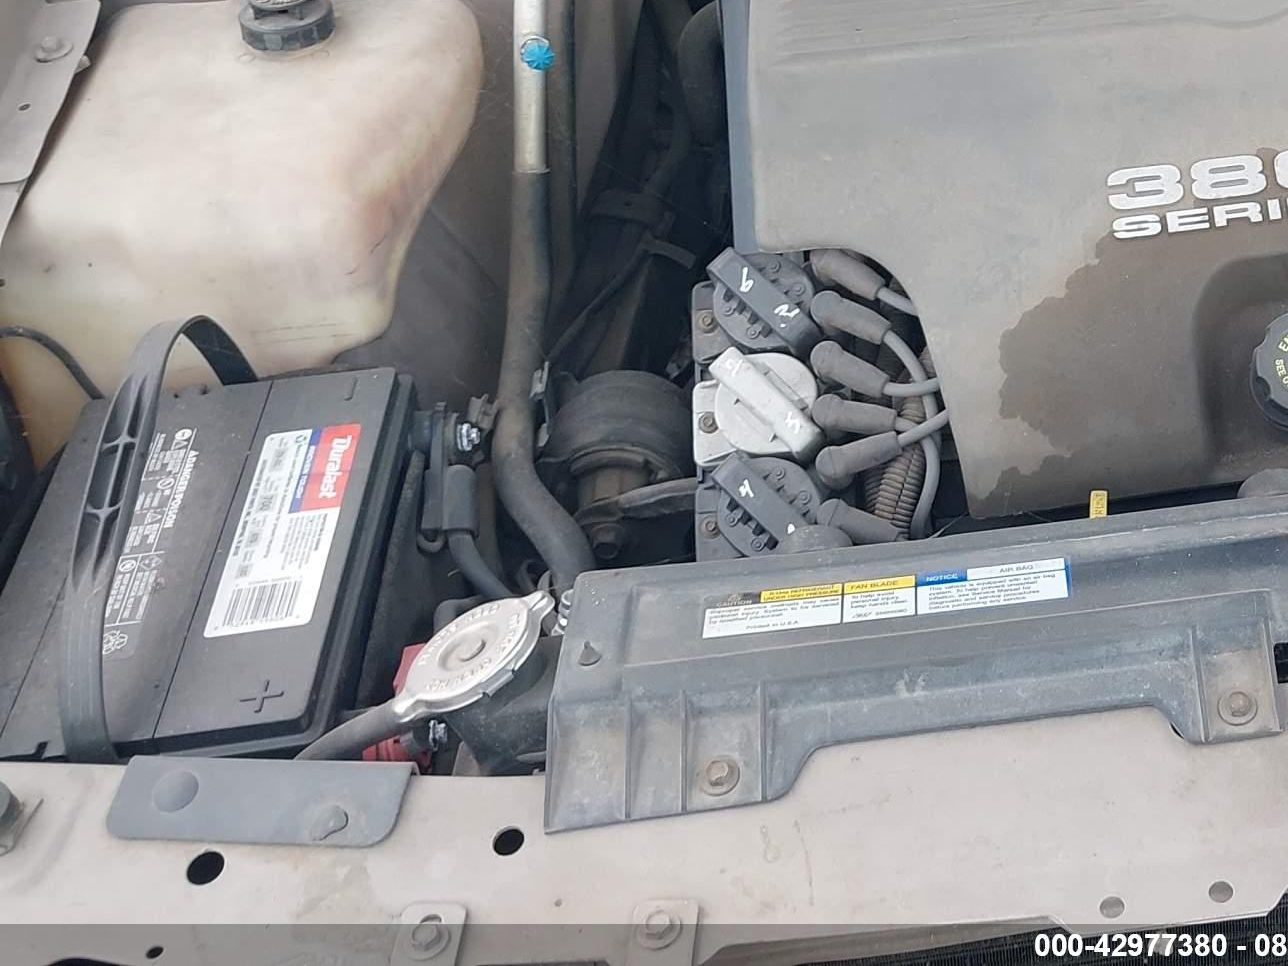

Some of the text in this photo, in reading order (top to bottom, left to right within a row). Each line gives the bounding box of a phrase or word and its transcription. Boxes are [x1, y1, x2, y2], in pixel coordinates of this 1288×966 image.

[1275, 359, 1287, 376] SEE
[318, 435, 352, 498] Duralast
[926, 573, 958, 581] NOTICE
[850, 579, 897, 590] FAN BLADE
[715, 599, 751, 607] CAUTION
